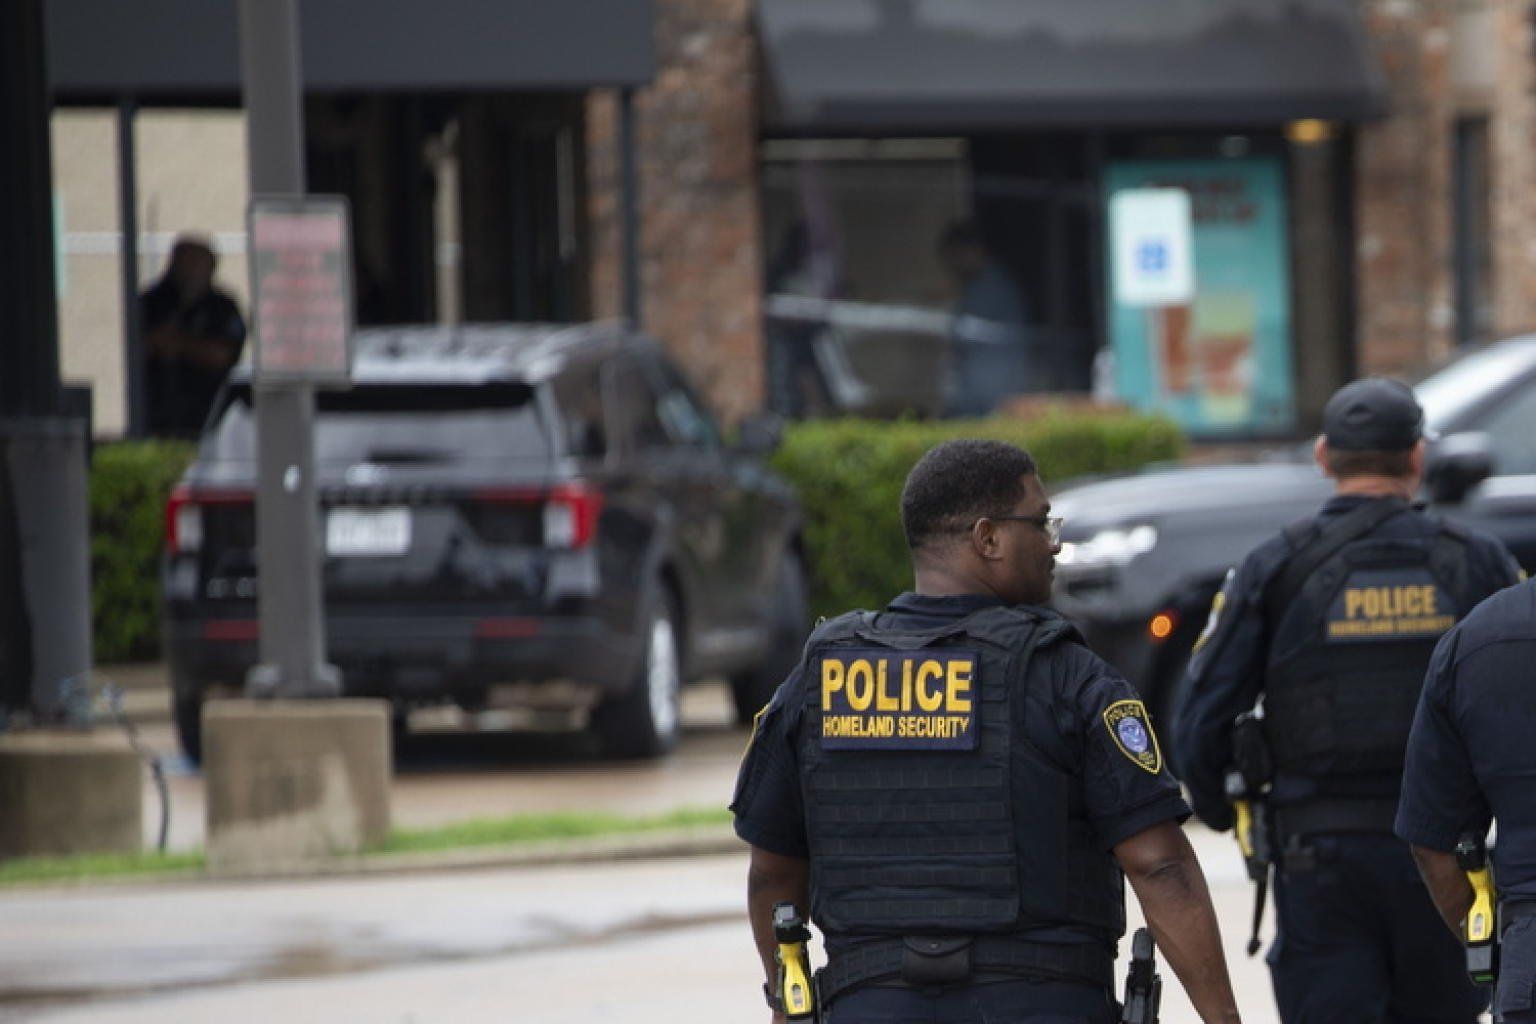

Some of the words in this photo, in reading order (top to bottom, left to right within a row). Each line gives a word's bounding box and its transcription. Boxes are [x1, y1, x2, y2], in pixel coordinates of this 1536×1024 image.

[1344, 585, 1437, 619] POLICE
[821, 658, 973, 712] POLICE
[822, 715, 894, 738] HOMELAND
[898, 715, 970, 738] SECURITY
